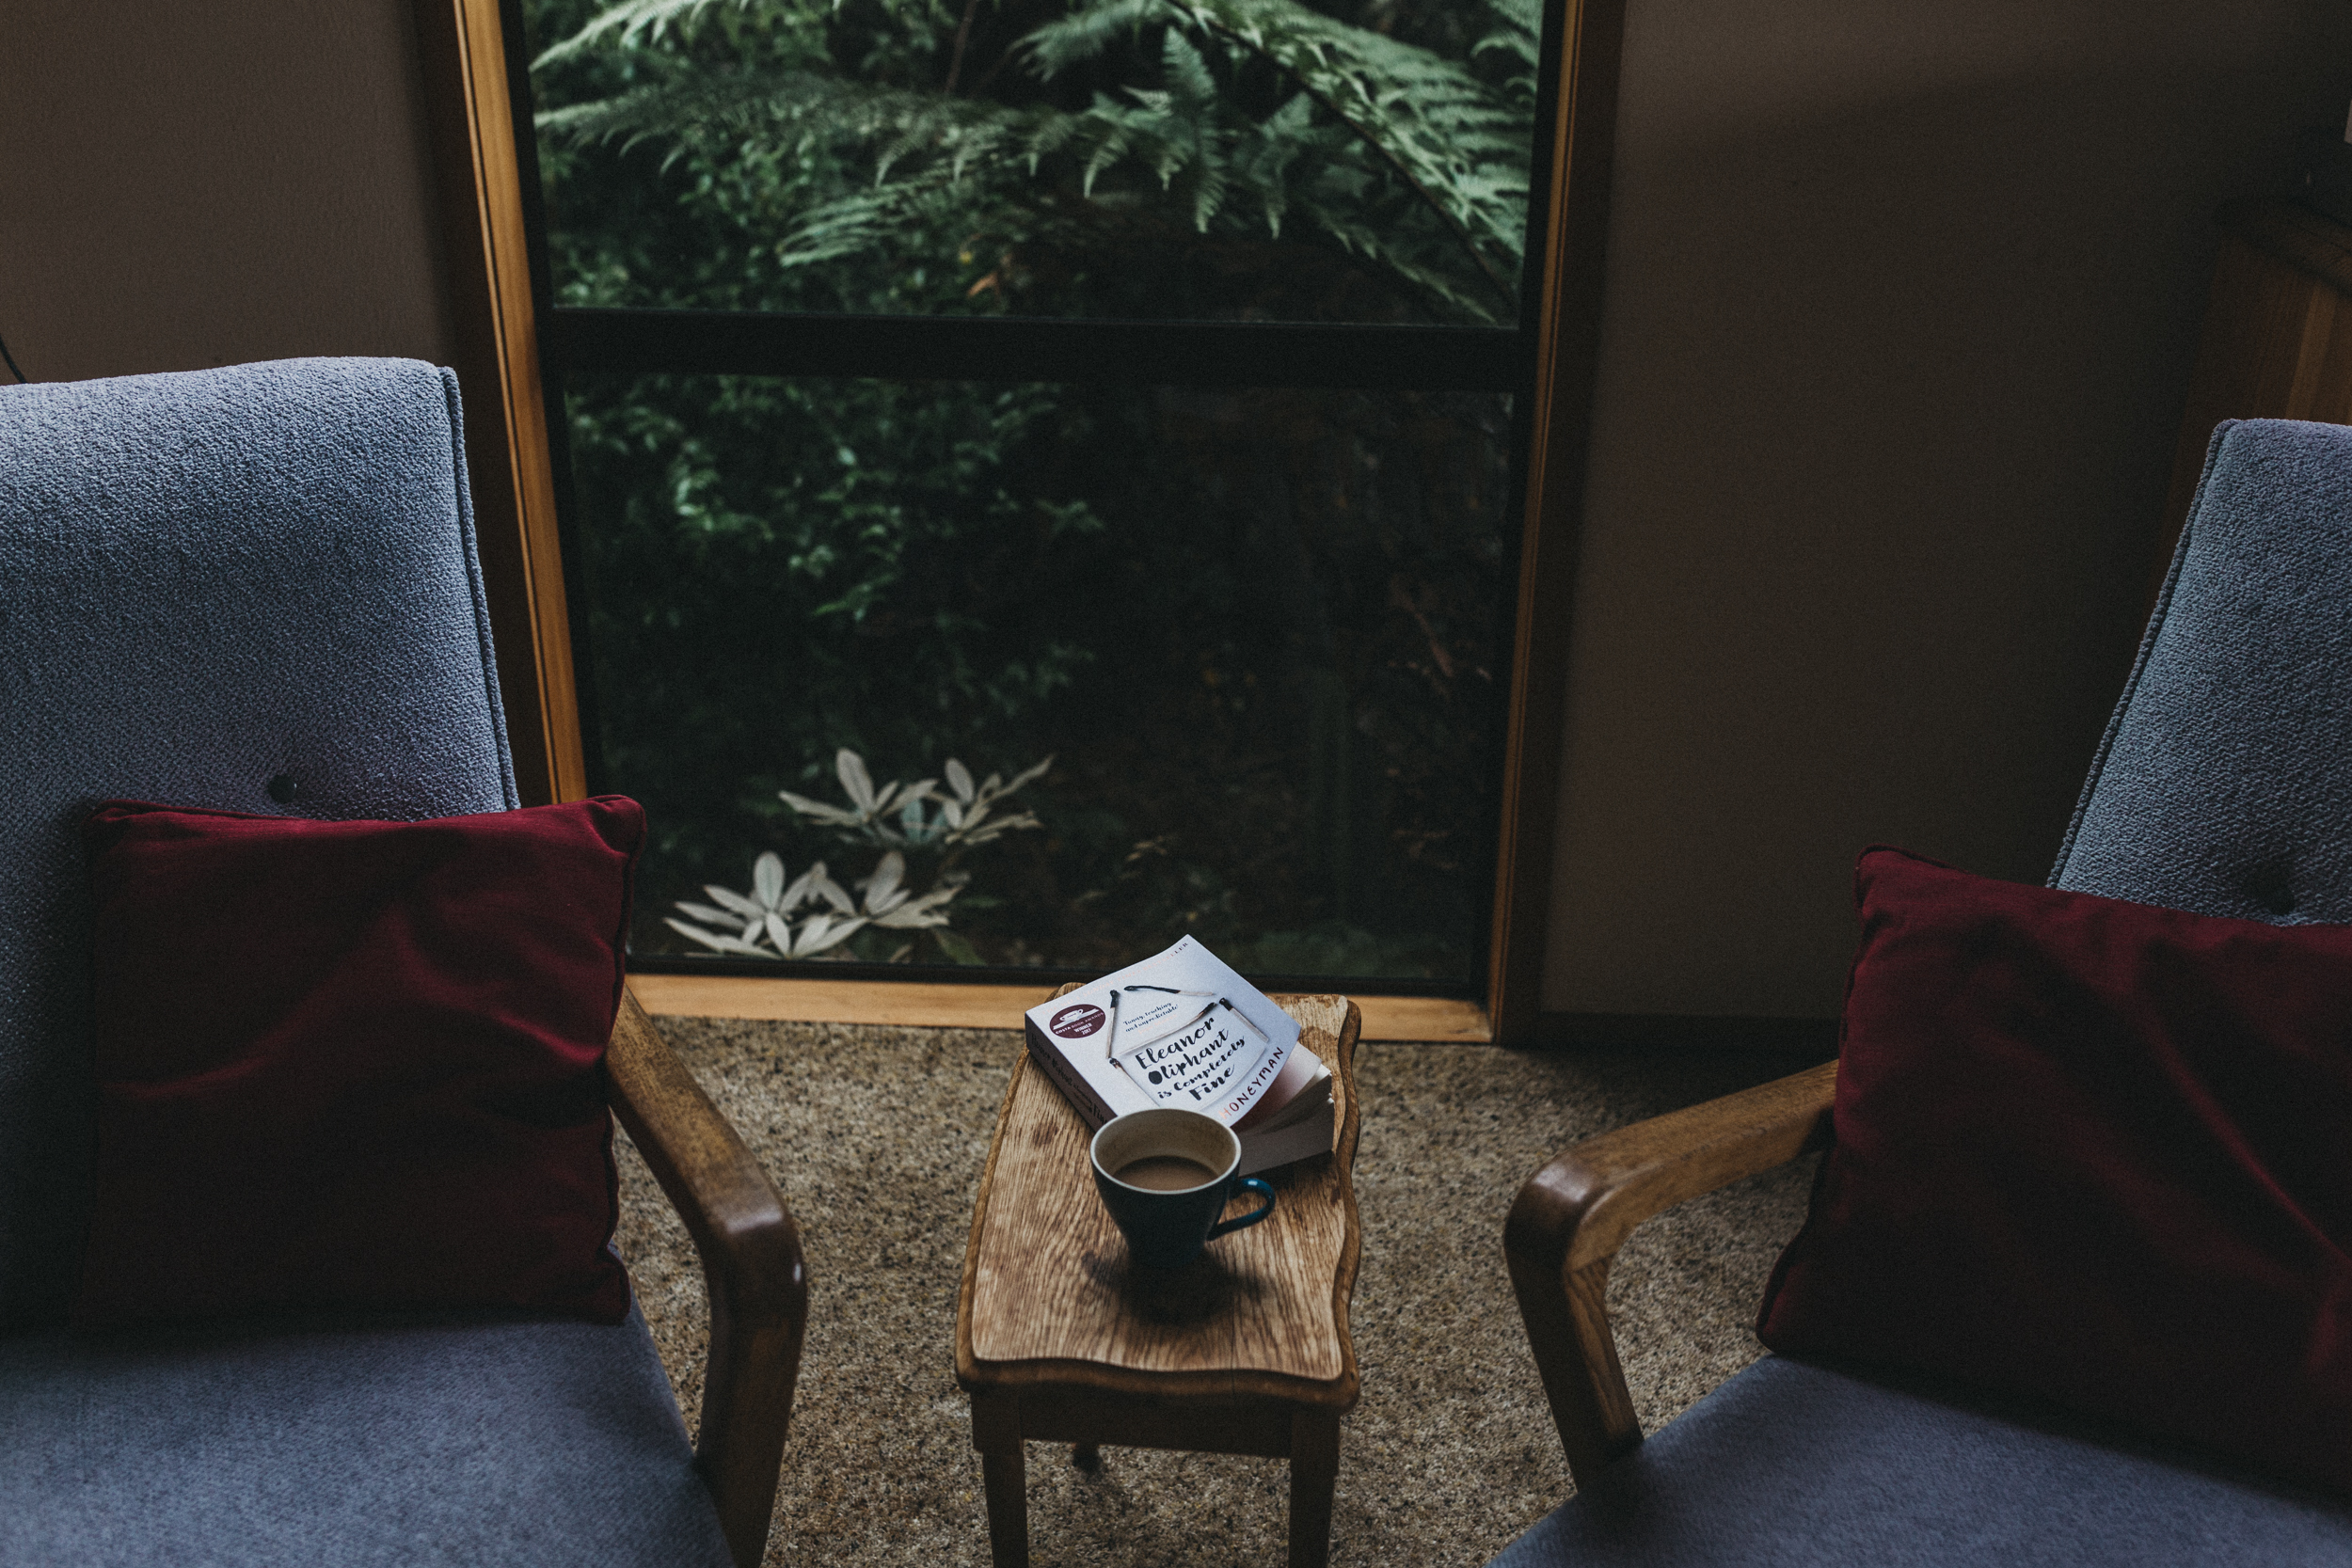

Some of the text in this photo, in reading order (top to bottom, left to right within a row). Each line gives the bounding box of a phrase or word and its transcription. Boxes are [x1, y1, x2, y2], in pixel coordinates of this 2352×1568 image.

[1055, 1026, 1072, 1035] COSTA
[1085, 1012, 1104, 1022] AWARDS
[1073, 1022, 1092, 1033] WINNER
[1125, 1023, 1138, 1033] and
[1144, 1002, 1172, 1017] touching
[1135, 1017, 1215, 1069] Eleanor
[1148, 1028, 1229, 1085] Oliphant
[1157, 1036, 1246, 1099] is Completely
[1188, 1064, 1235, 1101] Fine
[1217, 1046, 1284, 1120] HONEYMAN
